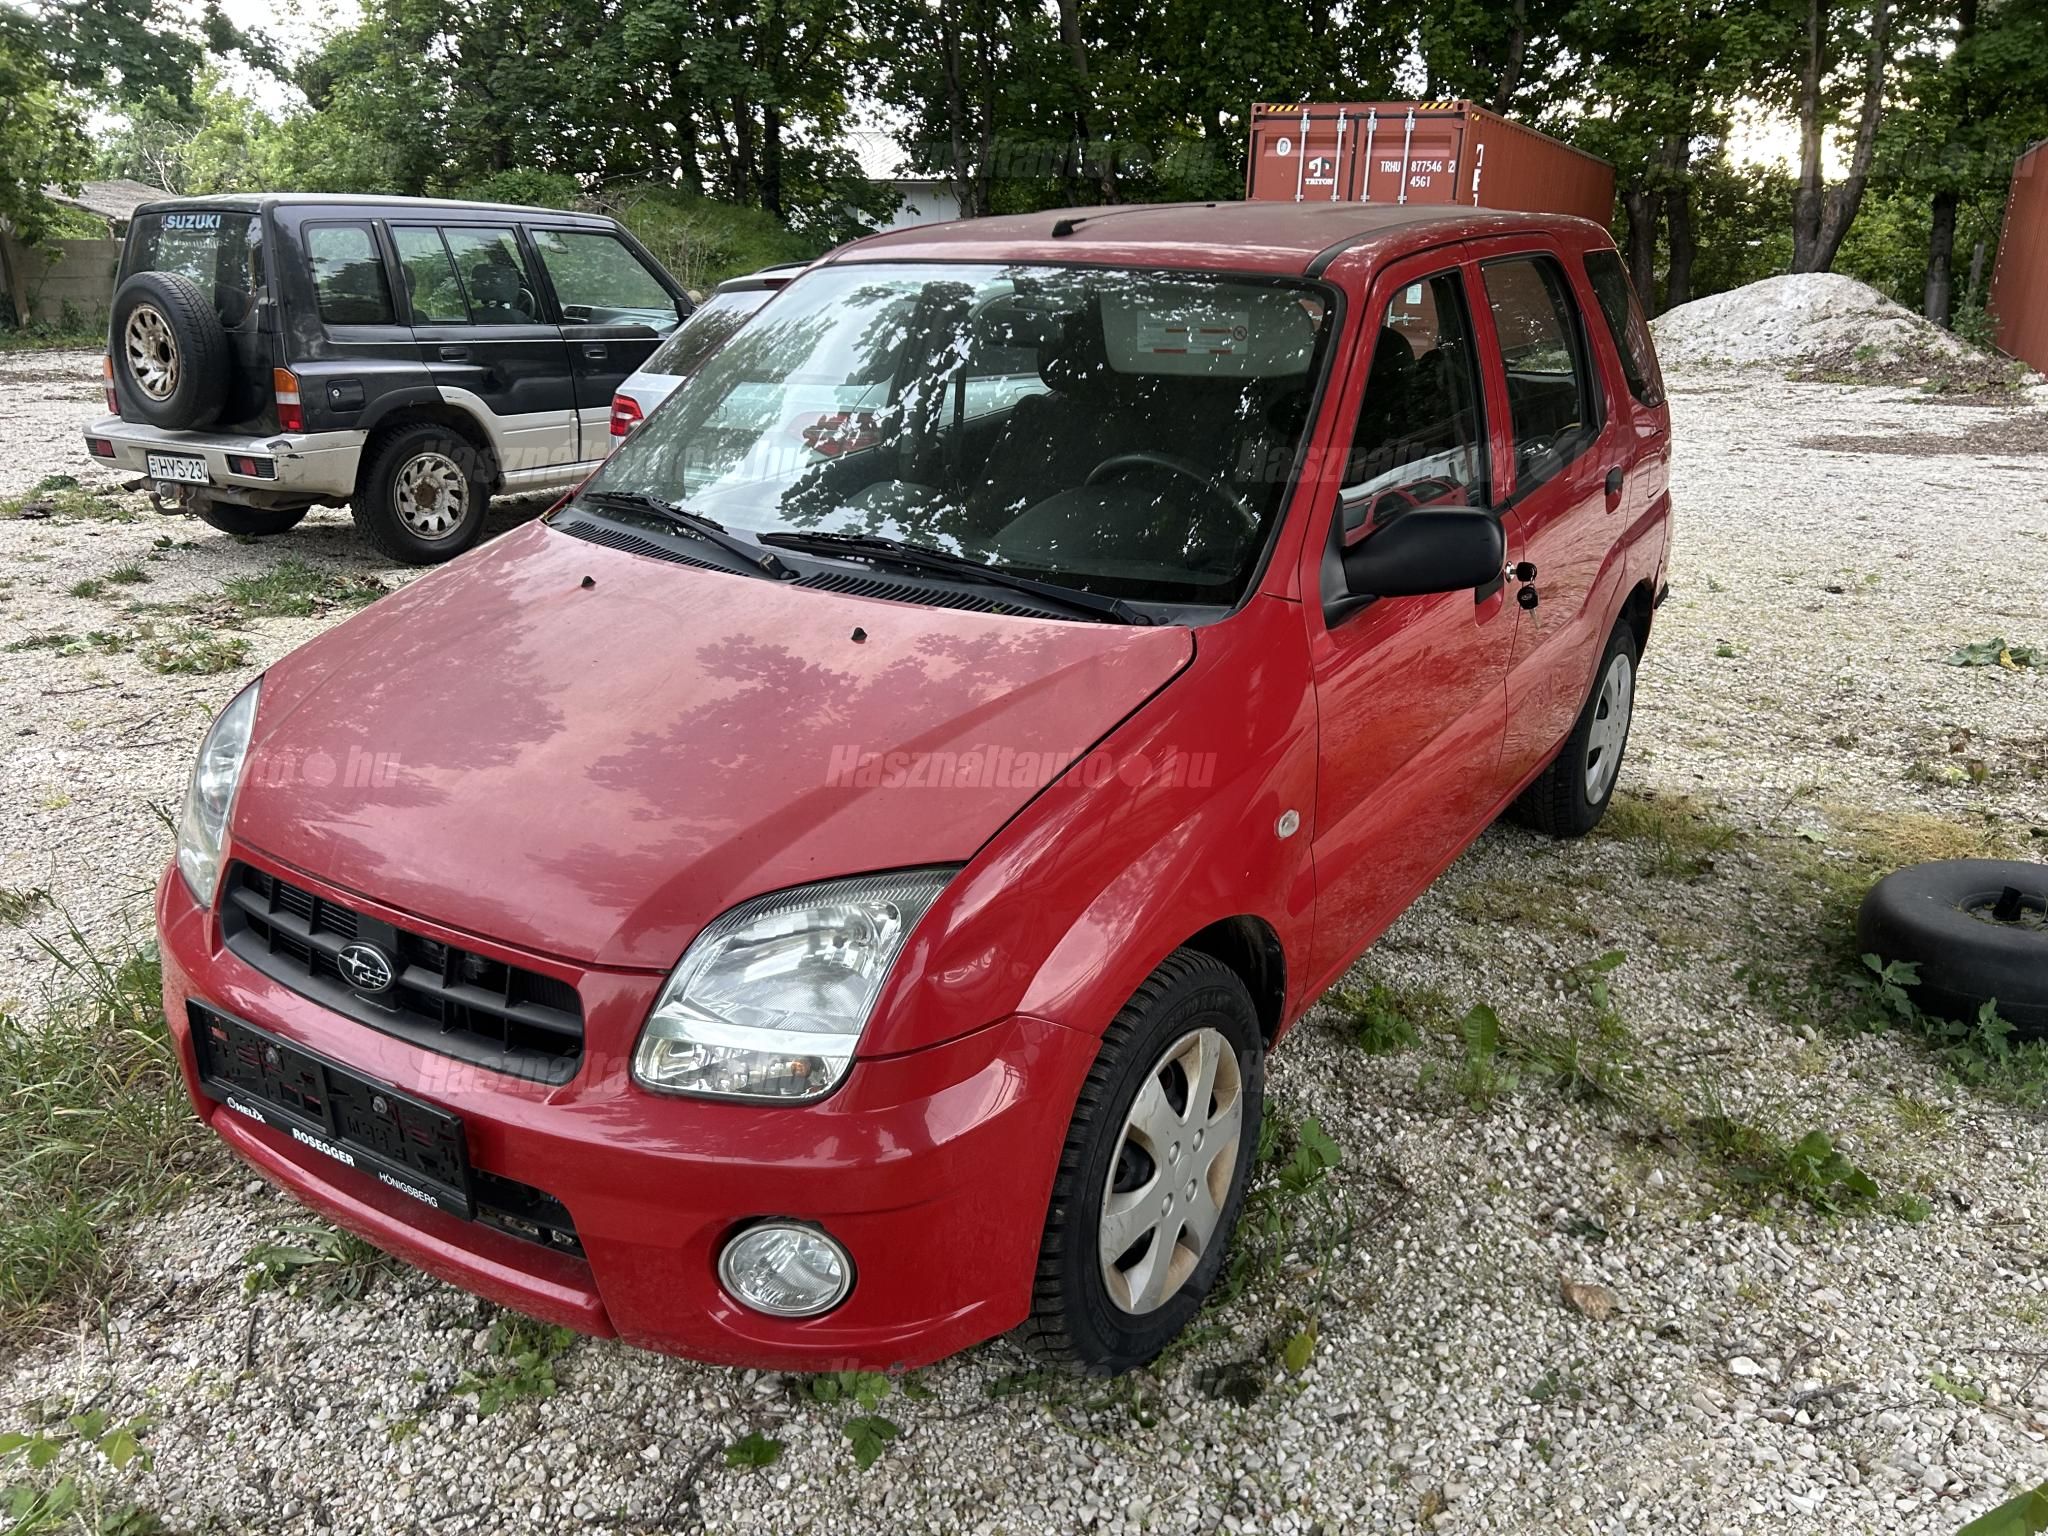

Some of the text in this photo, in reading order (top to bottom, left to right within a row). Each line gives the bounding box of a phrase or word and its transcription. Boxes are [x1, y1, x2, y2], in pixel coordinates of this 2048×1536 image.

[1380, 160, 1401, 173] TRHU
[1410, 160, 1442, 173] 877546
[1304, 178, 1334, 186] TRITON
[1410, 176, 1431, 188] 45G1
[165, 214, 221, 229] SUZUKI
[292, 1127, 355, 1168] ROSEGGER
